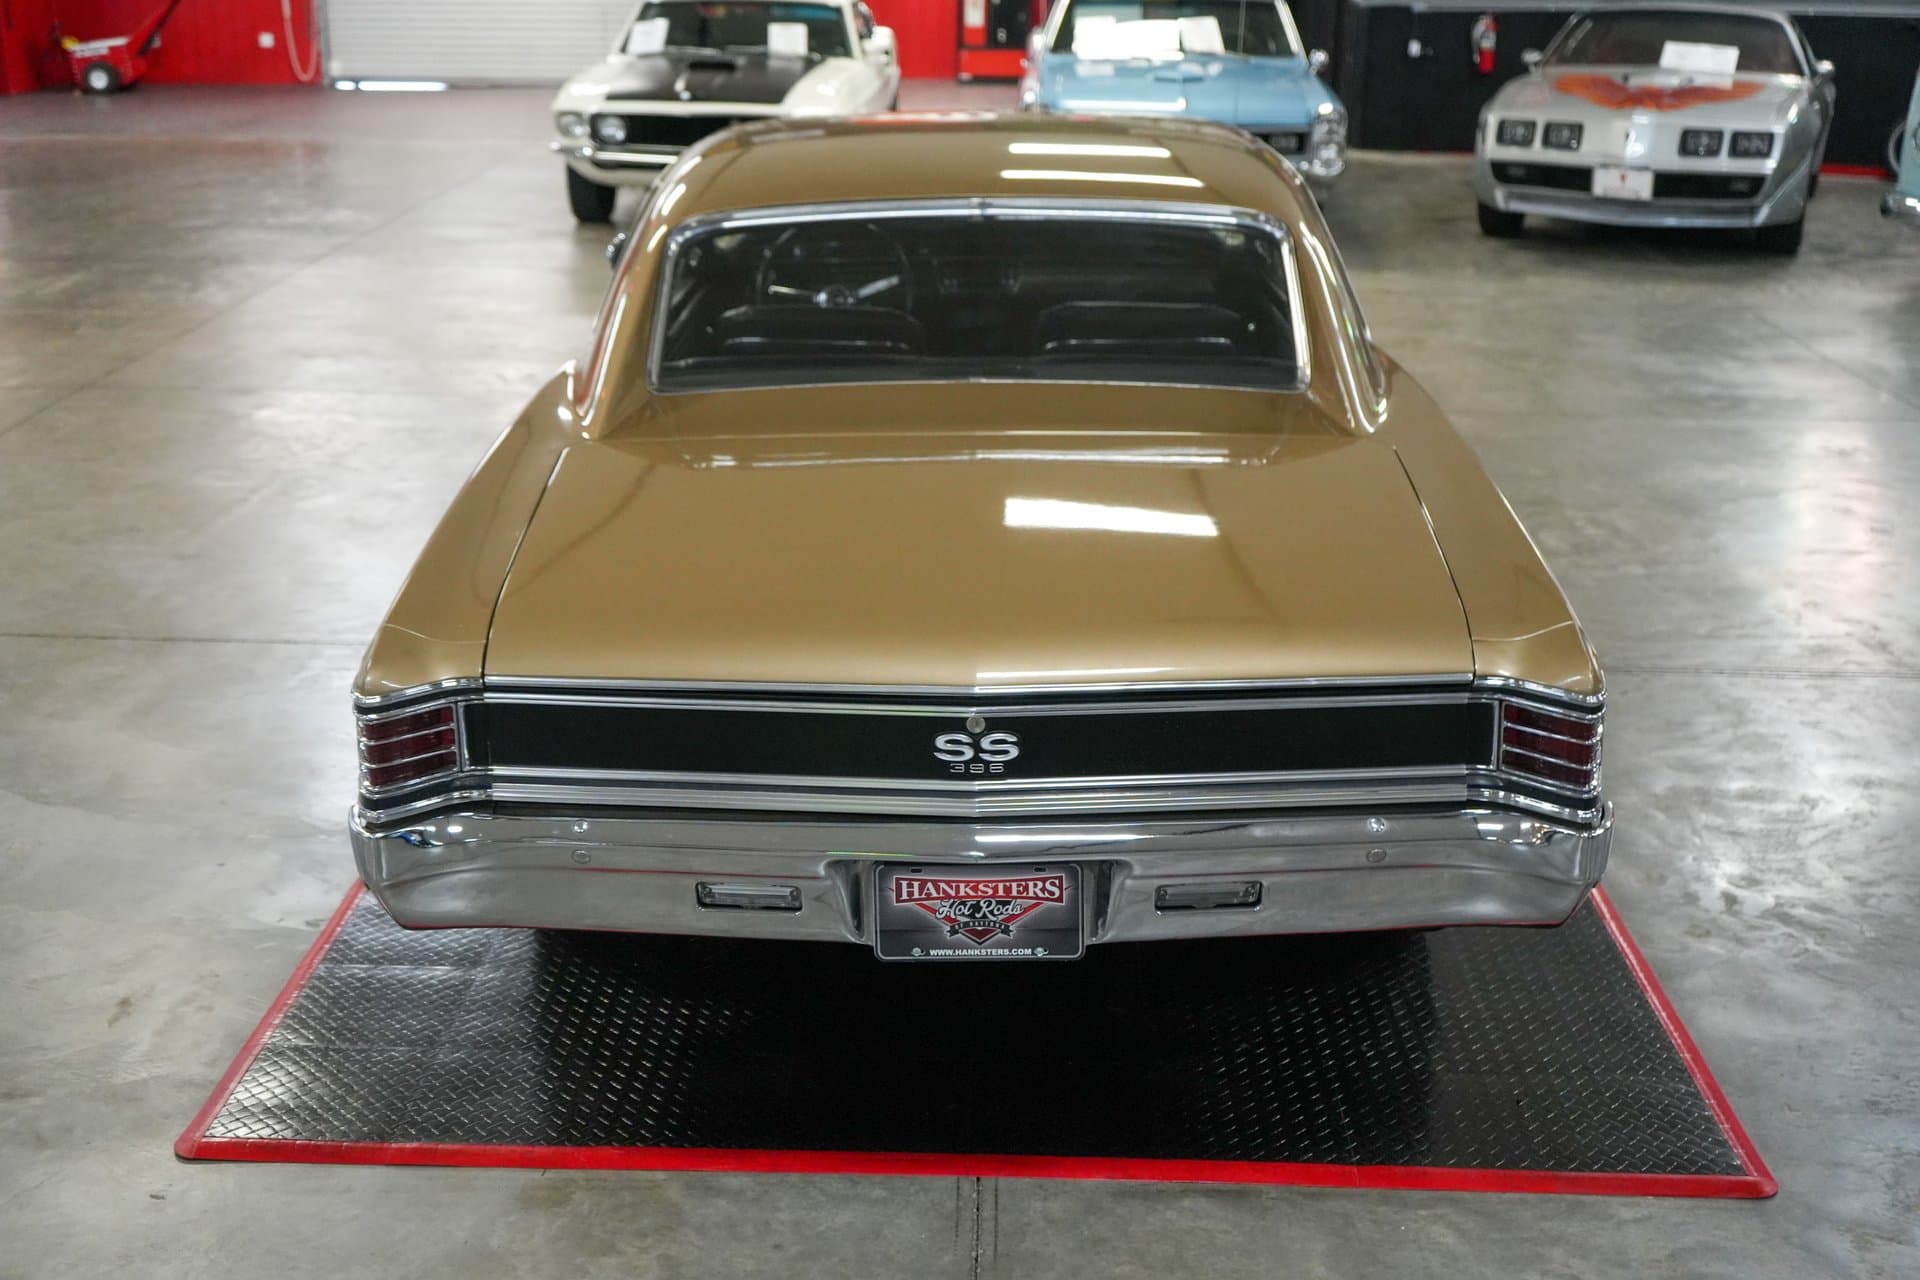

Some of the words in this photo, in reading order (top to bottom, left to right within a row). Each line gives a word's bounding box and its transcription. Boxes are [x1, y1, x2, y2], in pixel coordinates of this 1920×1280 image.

[933, 733, 1020, 762] SS
[949, 763, 1005, 773] 396
[899, 879, 1060, 900] HANKSTERS
[936, 899, 976, 919] Hot
[976, 899, 1025, 919] Rods
[929, 947, 1032, 956] WWW.HANKSTERS.COM
